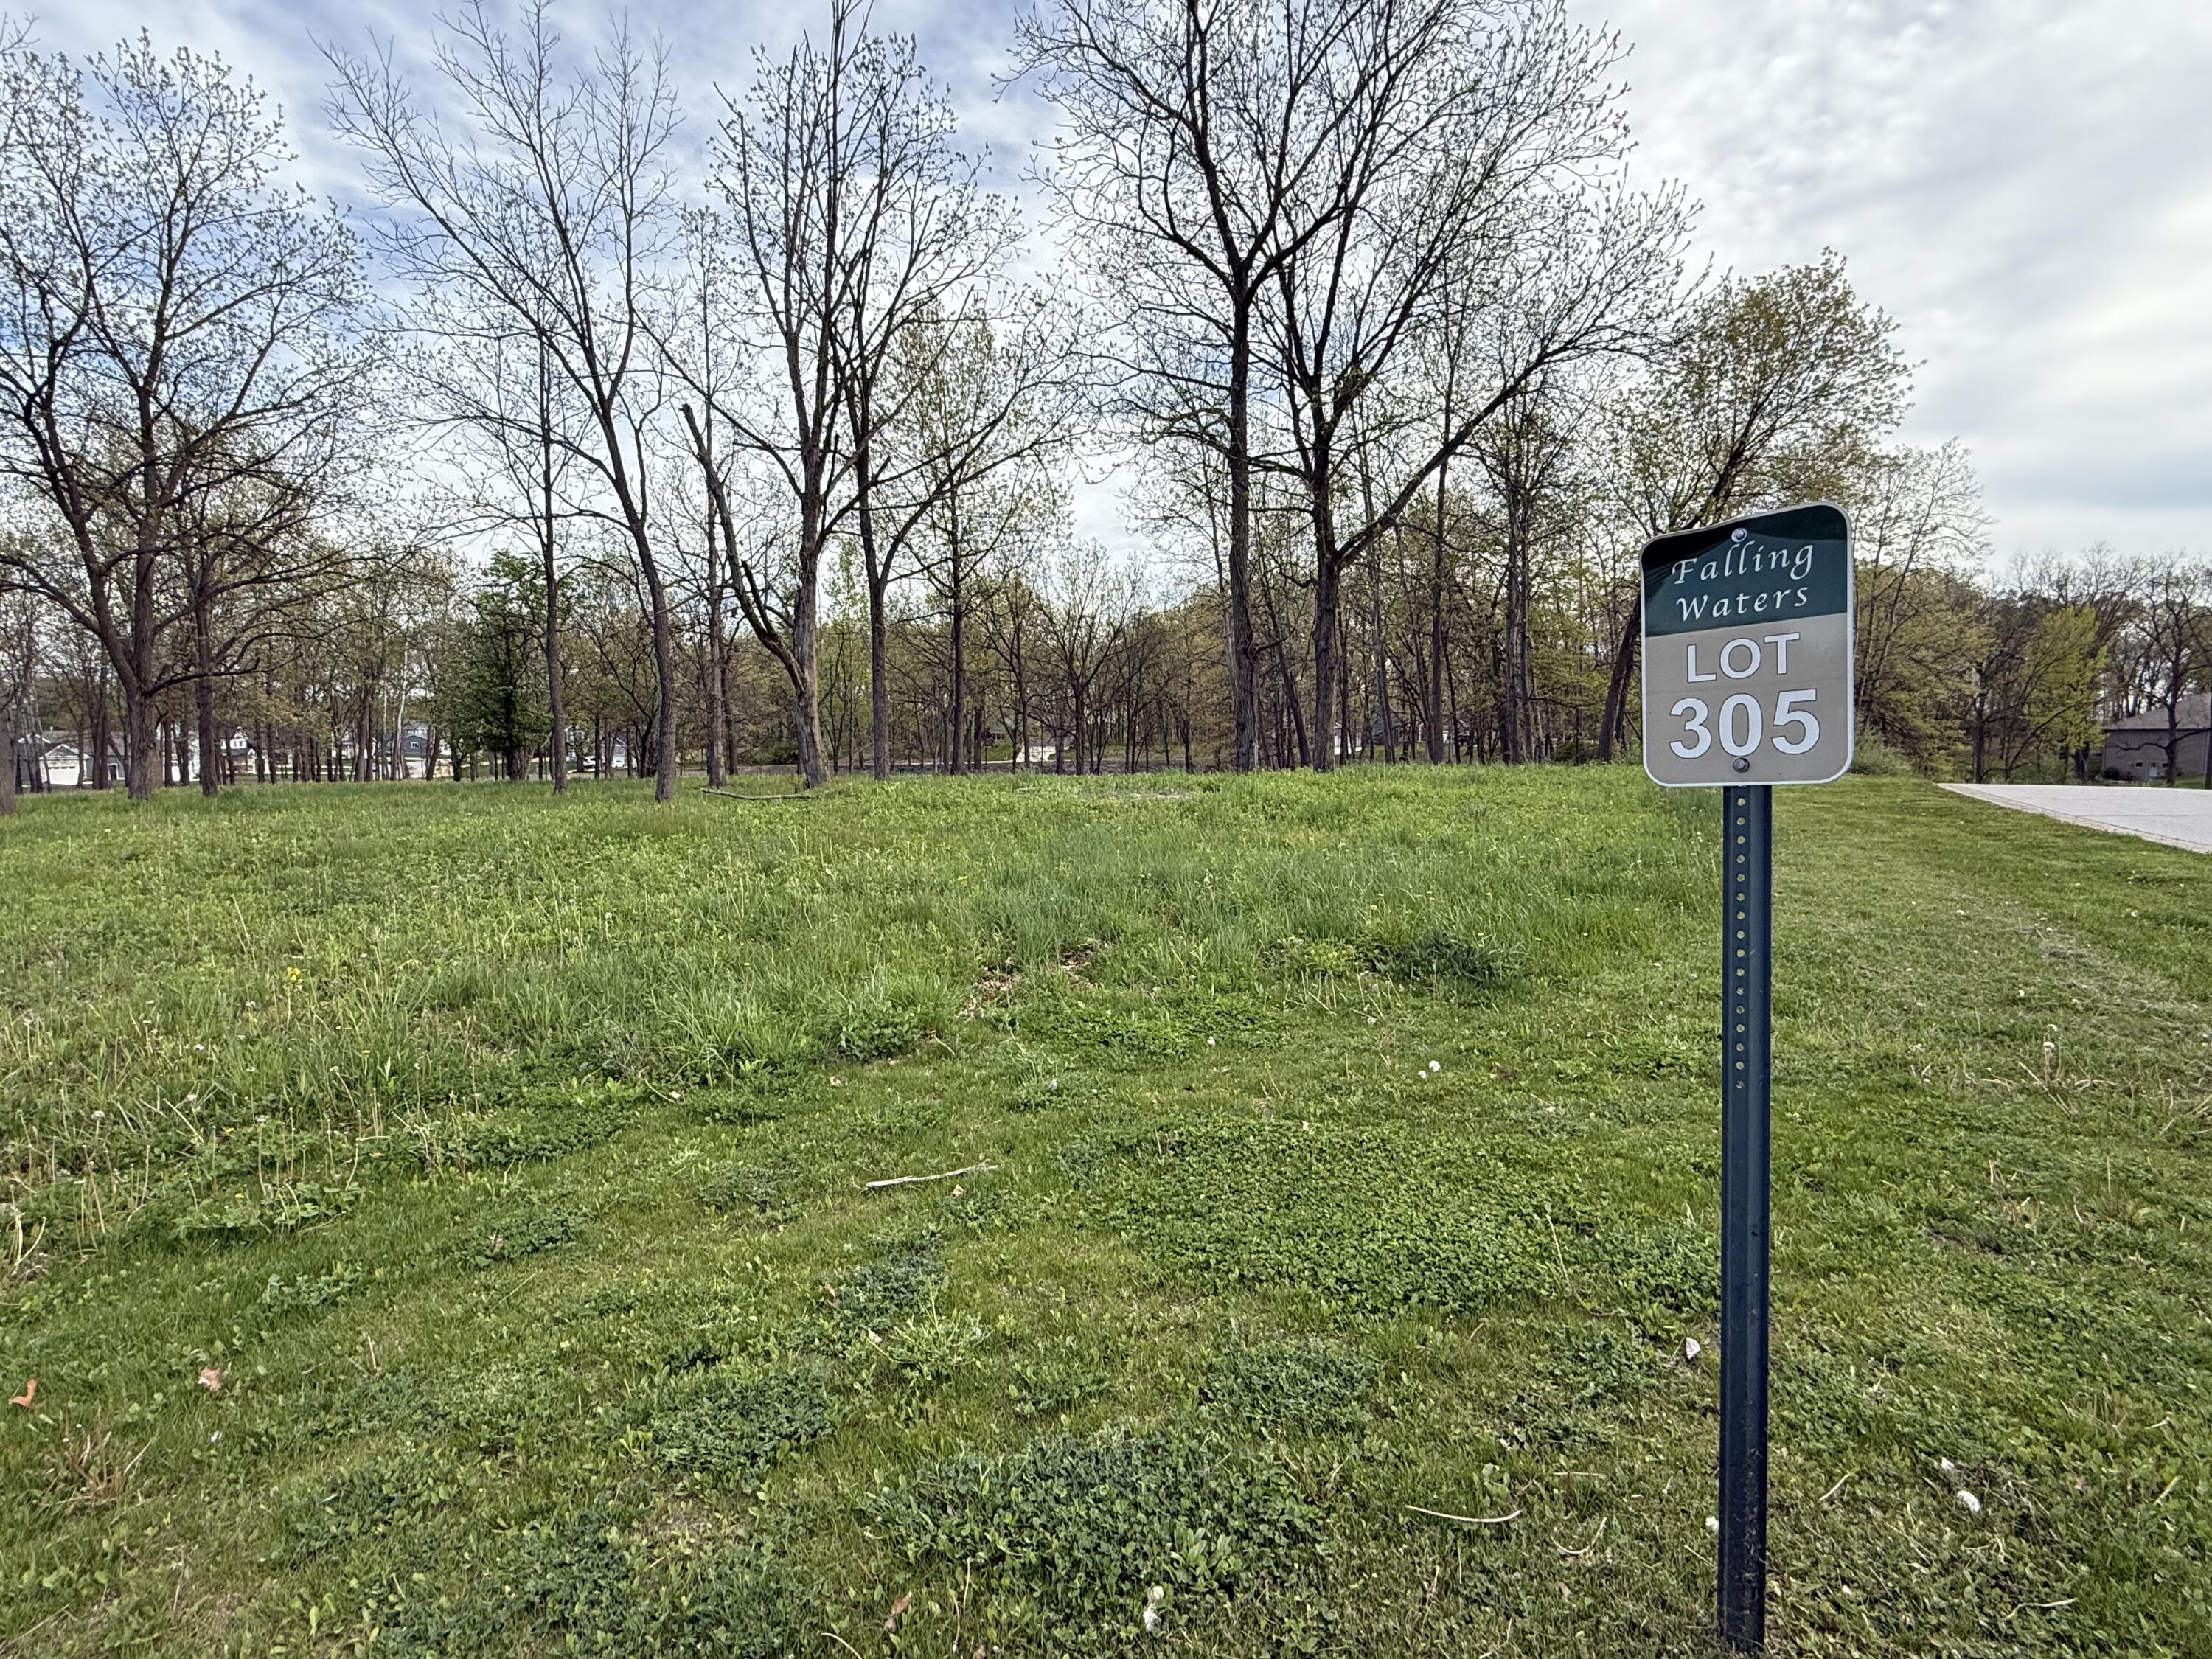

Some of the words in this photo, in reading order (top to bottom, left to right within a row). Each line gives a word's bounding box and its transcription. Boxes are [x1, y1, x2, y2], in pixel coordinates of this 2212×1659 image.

[1672, 540, 1813, 585] Falling
[1676, 587, 1808, 622] Waters
[1687, 632, 1800, 684] LOT
[1669, 689, 1820, 759] 305
